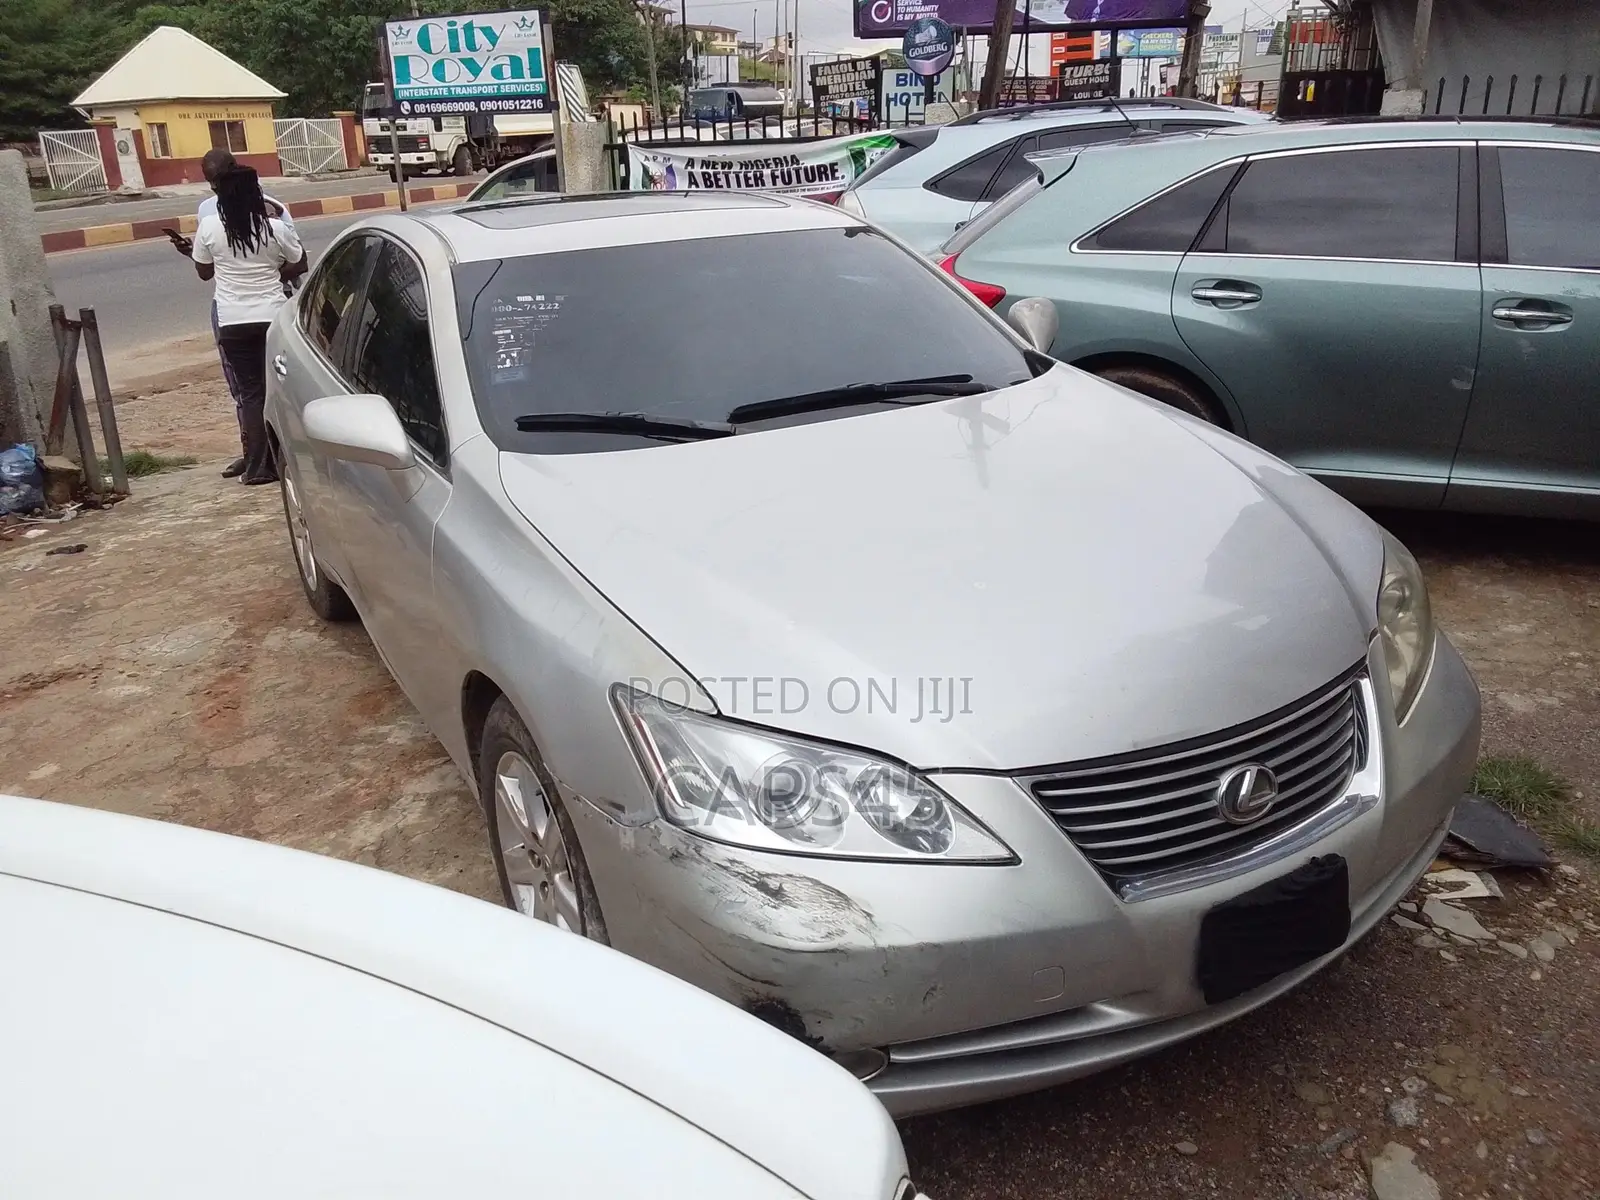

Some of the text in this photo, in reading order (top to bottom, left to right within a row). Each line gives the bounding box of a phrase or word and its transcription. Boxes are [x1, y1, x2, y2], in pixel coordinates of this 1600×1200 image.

[906, 4, 939, 13] HUMANITY
[416, 19, 506, 56] City
[909, 41, 948, 58] GOLDBERG
[393, 47, 544, 85] Royal
[817, 59, 872, 76] FAKOL DE
[815, 69, 876, 87] MERIDIAN
[1064, 74, 1110, 87] GUEST HOUS
[398, 83, 543, 98] (INTERSTATE TRANSPORT SERVICES)
[828, 80, 868, 95] MOTEL
[414, 99, 544, 113] 08169669008, 09010512216
[684, 157, 696, 170] A
[700, 159, 734, 171] NEW
[687, 161, 846, 189] A BETTER FUTURE.
